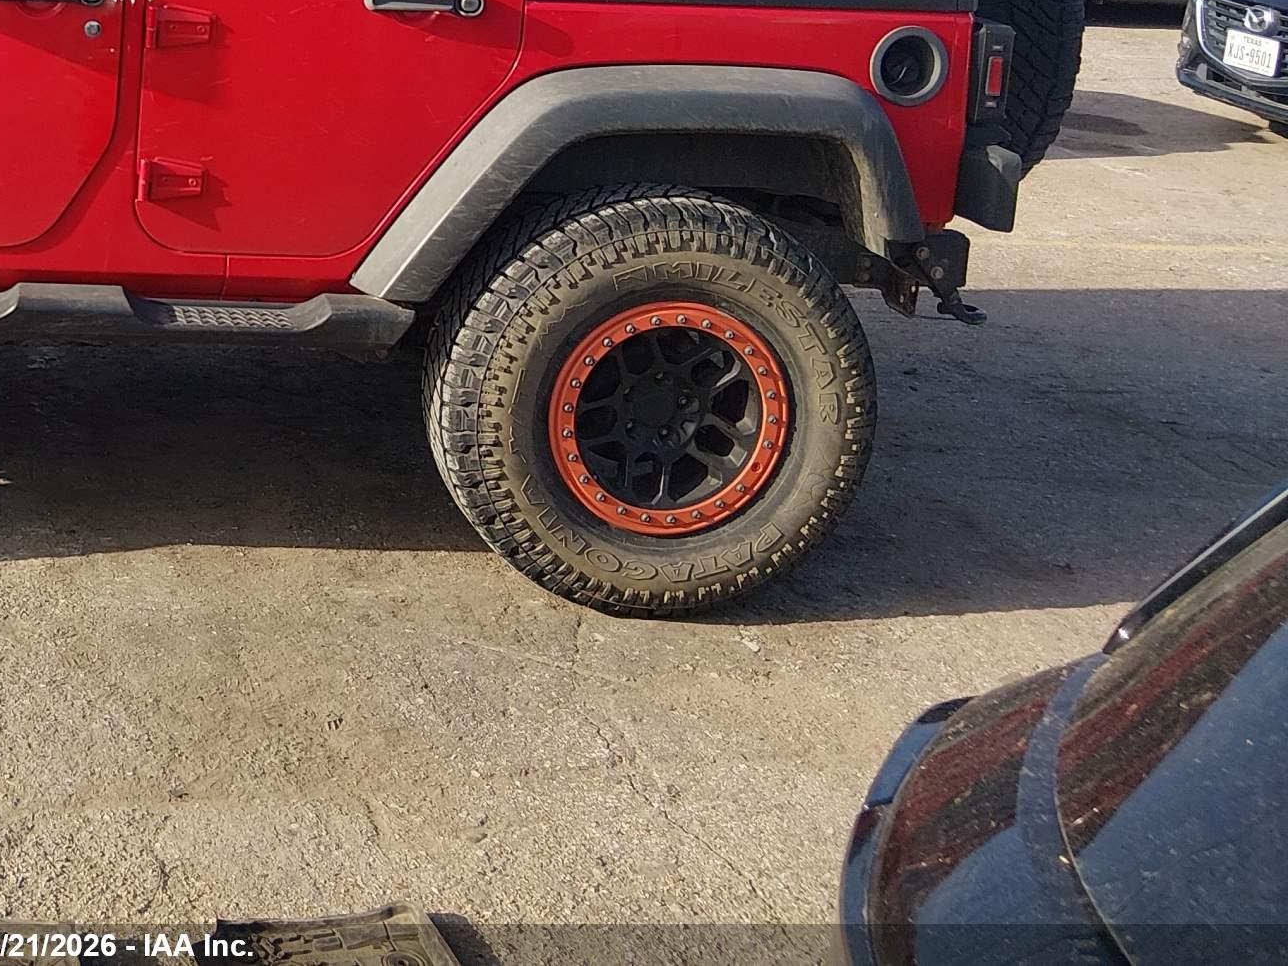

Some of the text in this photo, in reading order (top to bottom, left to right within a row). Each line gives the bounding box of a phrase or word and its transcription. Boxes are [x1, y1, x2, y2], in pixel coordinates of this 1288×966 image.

[1243, 35, 1263, 47] TEXAS
[650, 260, 843, 426] MILESTAR
[519, 473, 785, 584] PATAGONIA
